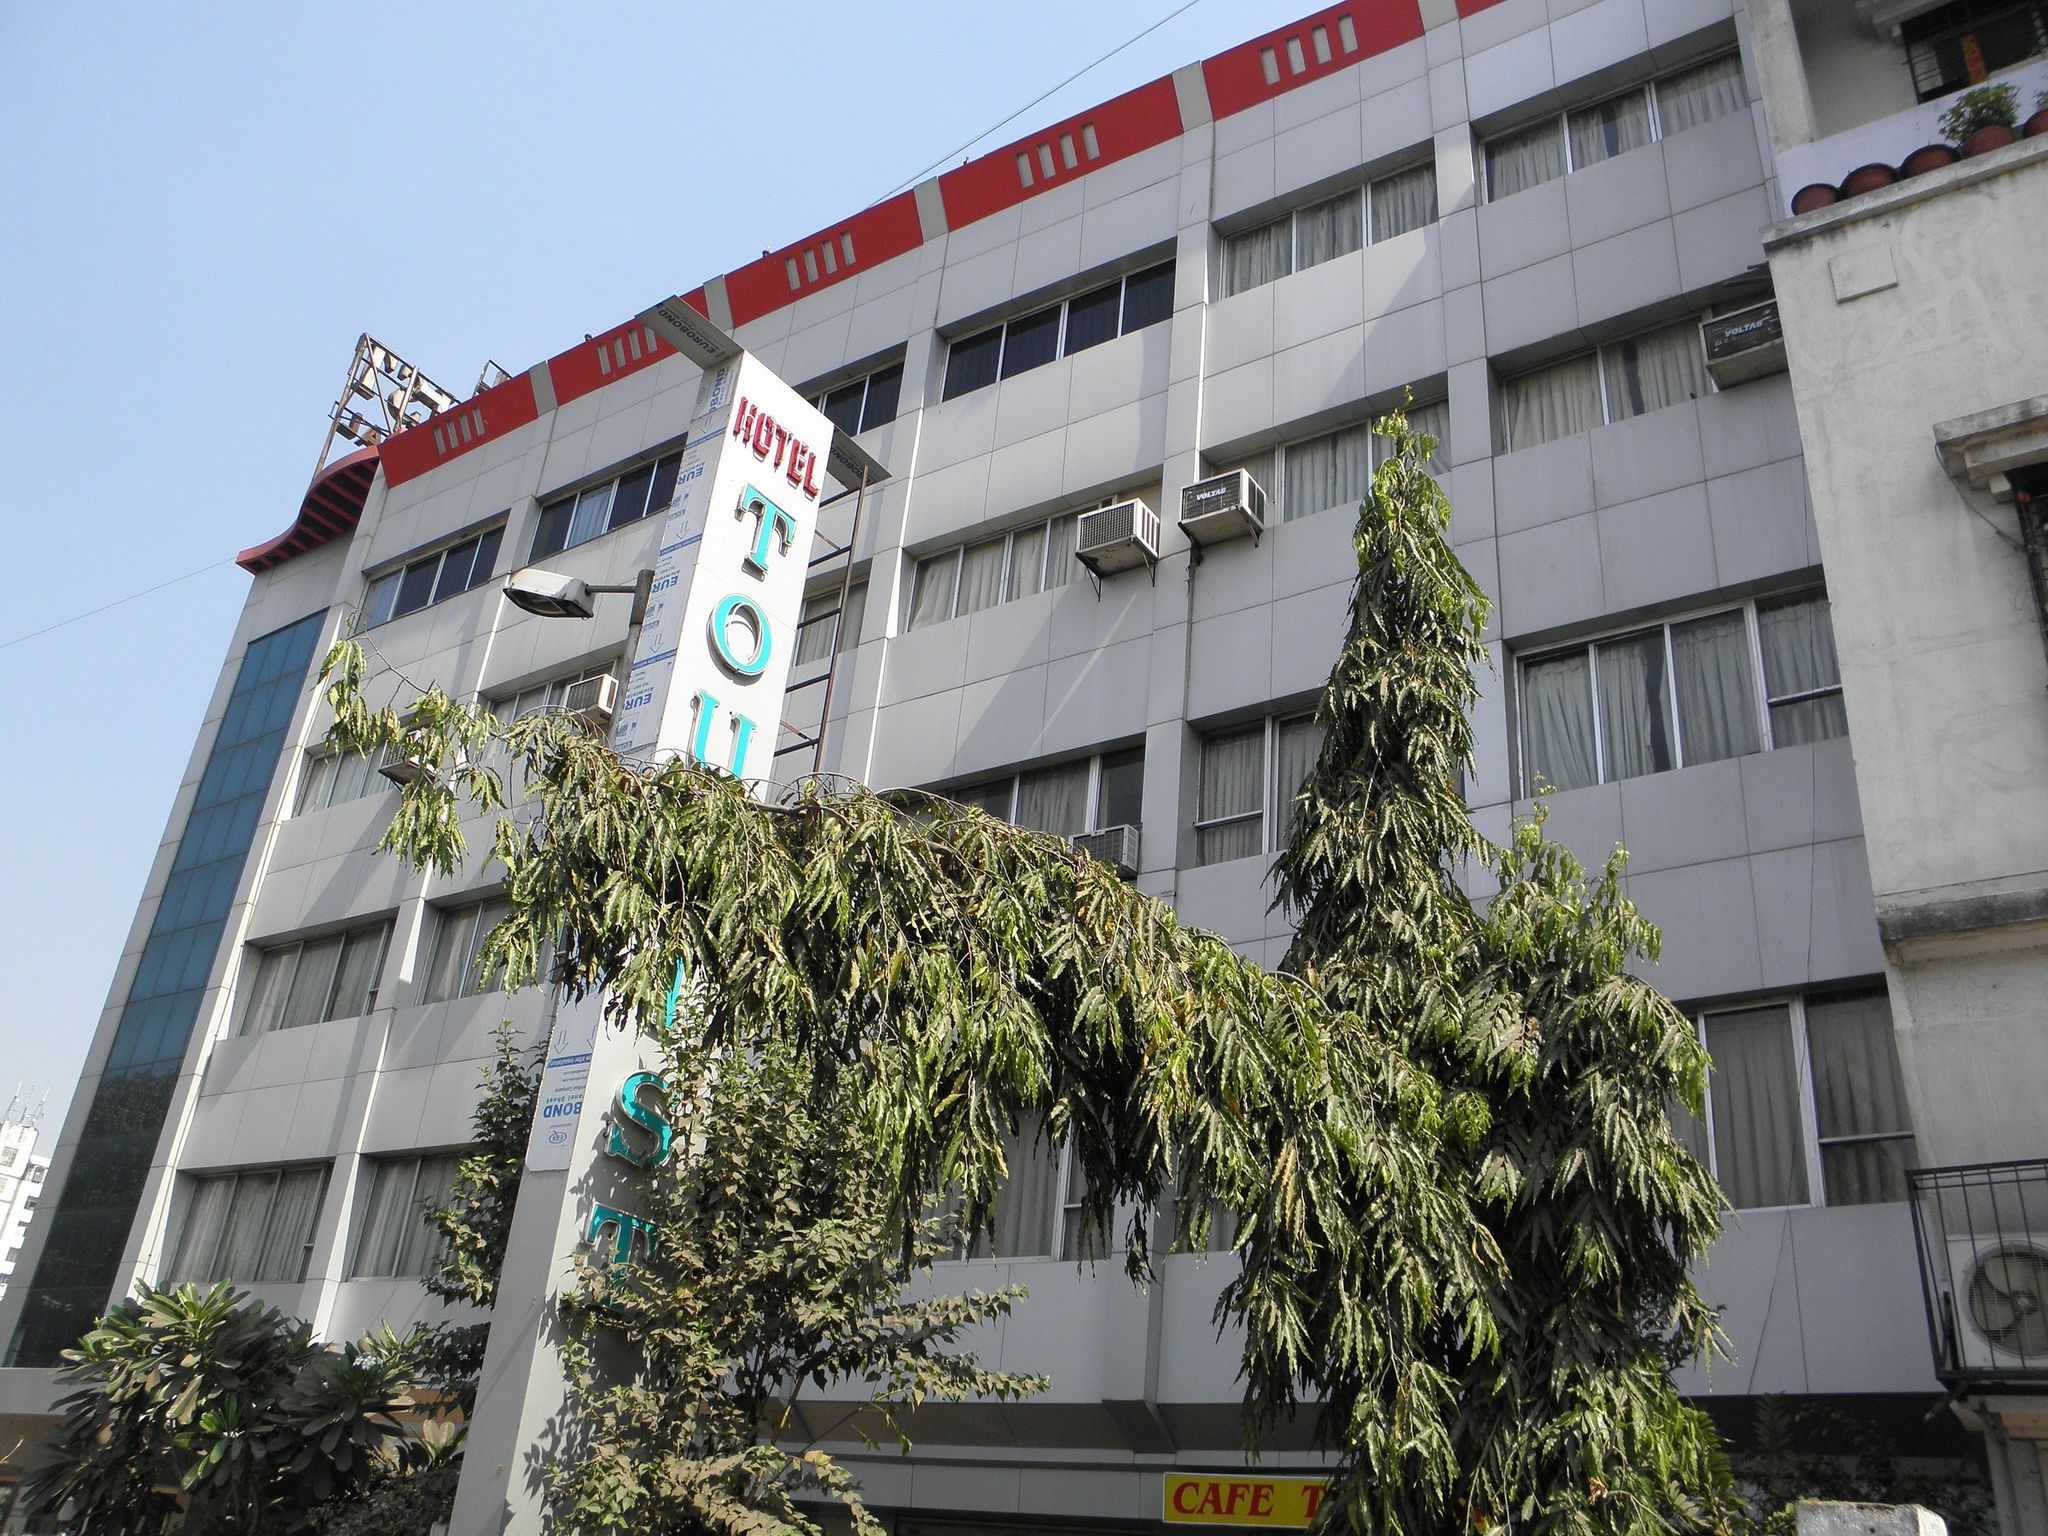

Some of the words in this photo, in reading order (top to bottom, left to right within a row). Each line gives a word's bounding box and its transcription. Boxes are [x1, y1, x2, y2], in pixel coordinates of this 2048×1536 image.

[658, 308, 716, 354] EUROBOND
[1724, 320, 1764, 338] VOLTAS
[733, 396, 819, 499] HOTEL
[1196, 487, 1227, 501] VOLTAS
[651, 575, 679, 593] EUR
[624, 692, 653, 711] EUR
[543, 1101, 583, 1119] BOND
[1172, 1481, 1275, 1518] CAFE
[1300, 1485, 1328, 1519] T
